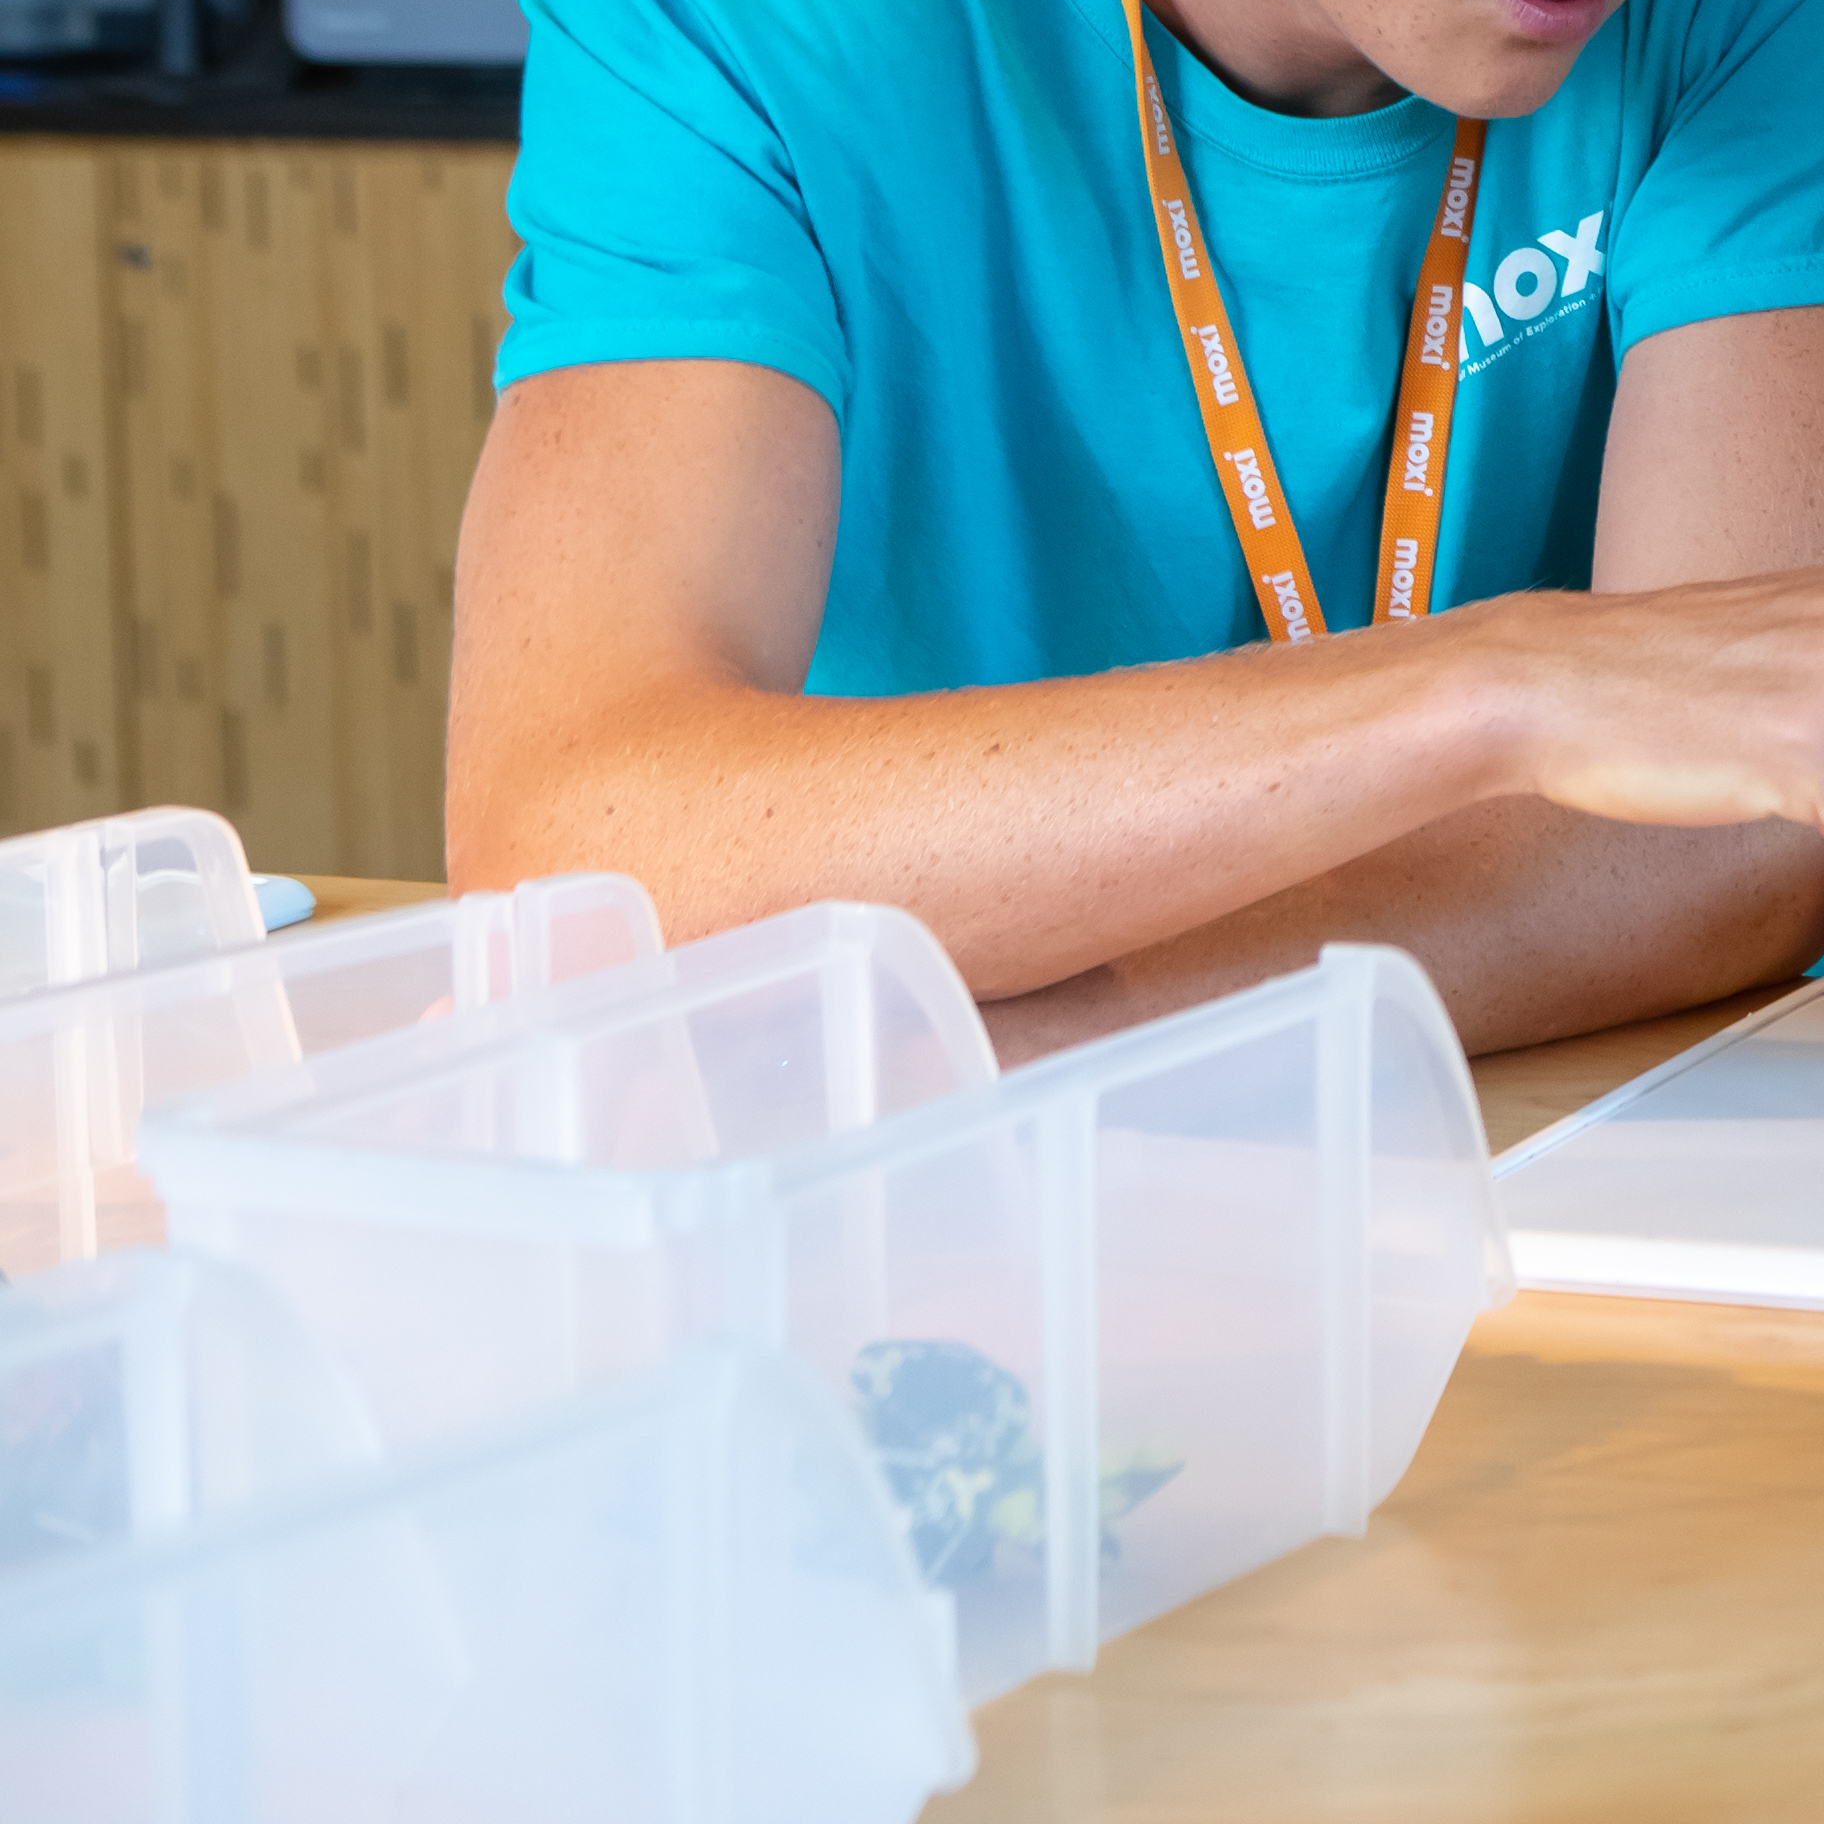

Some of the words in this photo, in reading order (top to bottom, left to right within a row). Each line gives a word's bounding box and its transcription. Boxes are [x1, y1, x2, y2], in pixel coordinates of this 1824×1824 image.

[1161, 198, 1201, 281] moxi
[1440, 156, 1476, 244] moxi
[1190, 323, 1240, 407] moxi
[1421, 284, 1454, 371] moxi
[1467, 342, 1512, 375] Museum
[1513, 329, 1524, 345] of
[1526, 298, 1587, 337] Exploration
[1223, 447, 1277, 531] moxi
[1403, 411, 1434, 497] moxi
[1388, 537, 1419, 621] moxi
